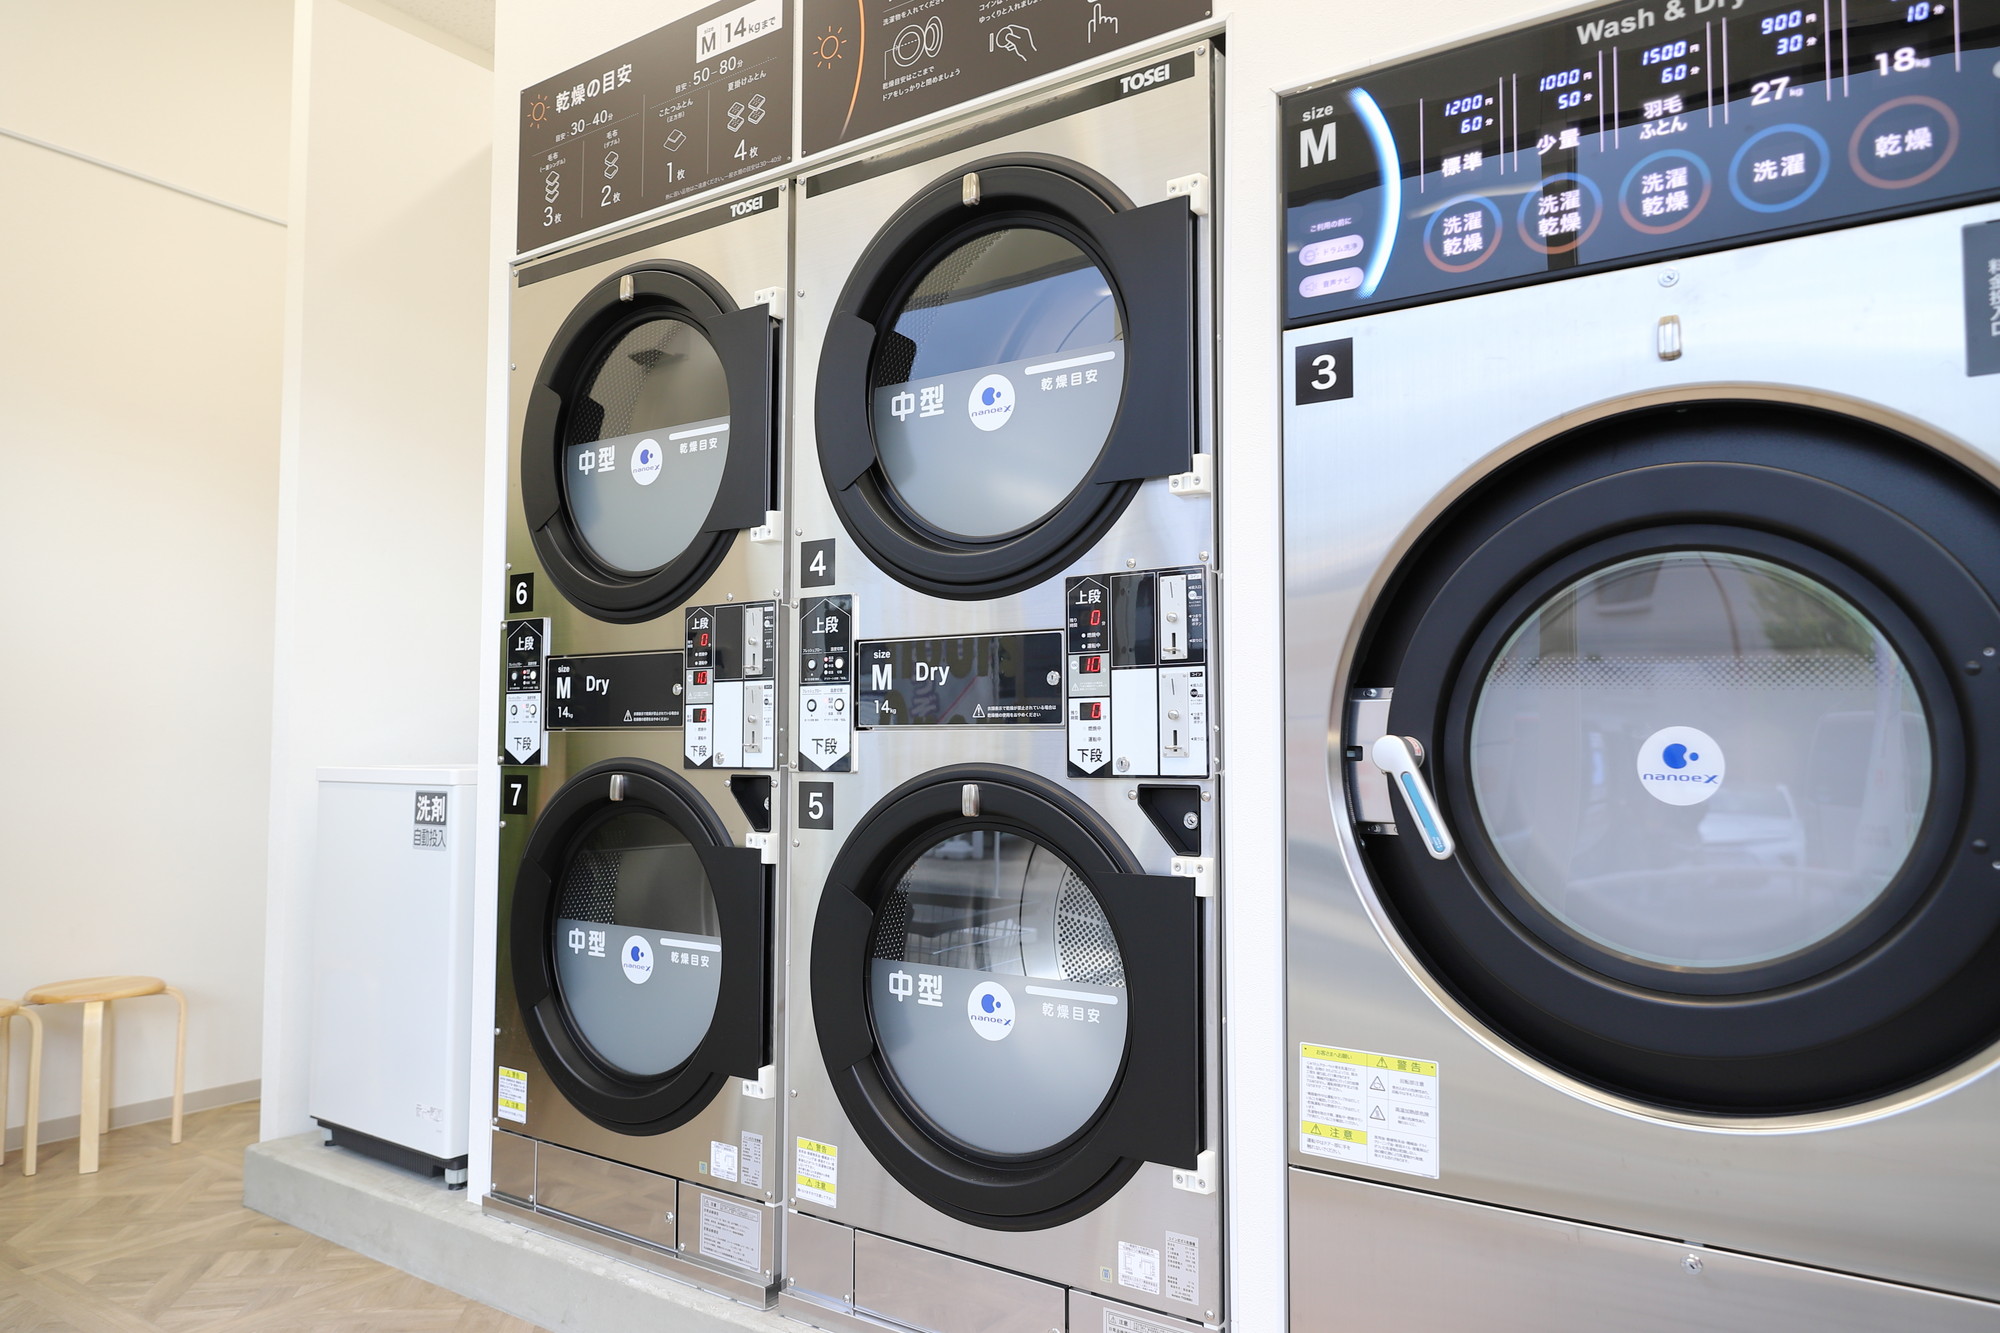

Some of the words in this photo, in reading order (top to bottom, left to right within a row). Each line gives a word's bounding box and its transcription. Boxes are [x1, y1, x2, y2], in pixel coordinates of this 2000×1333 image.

[883, 0, 944, 26] 洗濯物を入れてくださ
[1576, 8, 1655, 45] Wash
[1664, 0, 1686, 21] &
[702, 32, 716, 55] M
[555, 63, 632, 113] 乾燥の目安
[1120, 64, 1170, 94] TOSEI
[659, 98, 693, 117] こたつふとん
[1302, 104, 1333, 122] size
[1643, 95, 1683, 118] 羽毛
[1640, 116, 1687, 141] ふとん
[734, 139, 758, 161] 4枚
[1300, 122, 1337, 168] M
[1537, 127, 1580, 155] 少量
[1874, 126, 1933, 157] 乾燥
[667, 162, 685, 183] 1枚
[1442, 151, 1482, 178] 標準
[1753, 153, 1805, 182] 洗濯
[1641, 167, 1688, 194] 洗濯
[601, 185, 621, 207] 2枚
[730, 196, 763, 217] TOSEI
[1538, 190, 1580, 216] 洗濯
[1641, 191, 1689, 216] 乾燥
[543, 206, 562, 226] 3枚
[1310, 218, 1352, 232] ご利用の前に
[1443, 211, 1482, 236] 洗濯
[1538, 212, 1581, 238] 乾燥
[1442, 232, 1483, 257] 乾燥
[1040, 368, 1098, 391] 乾燥目安
[1311, 354, 1337, 390] 3
[891, 384, 944, 422] 中型
[679, 438, 718, 454] 乾燥目安
[578, 444, 615, 476] 中型
[809, 550, 827, 577] 4
[516, 582, 528, 605] 6
[1075, 588, 1102, 605] 上段
[692, 617, 709, 630] 上段
[812, 616, 839, 634] 上段
[1090, 610, 1100, 625] 0
[515, 636, 534, 651] 上段
[700, 633, 708, 646] 0
[873, 650, 891, 659] size
[1086, 656, 1101, 672] 10
[558, 665, 570, 673] size
[697, 671, 707, 684] 10
[872, 663, 892, 691] M
[916, 662, 950, 686] Dry
[556, 676, 571, 699] M
[586, 676, 610, 695] Dry
[874, 700, 896, 715] 14kg
[1091, 702, 1101, 718] 0
[514, 737, 532, 751] 下段
[690, 745, 707, 757] 下段
[812, 738, 838, 755] 下段
[1077, 748, 1102, 762] 下段
[510, 784, 522, 806] 7
[808, 792, 824, 820] 5
[416, 795, 445, 822] 洗剤
[413, 828, 446, 848] 自動投入
[568, 928, 606, 958] 中型
[670, 951, 710, 968] 乾燥目安
[889, 970, 943, 1007] 中型
[1042, 1002, 1100, 1024] 乾燥目安
[1397, 1060, 1421, 1072] 警告
[1330, 1127, 1353, 1140] 注意
